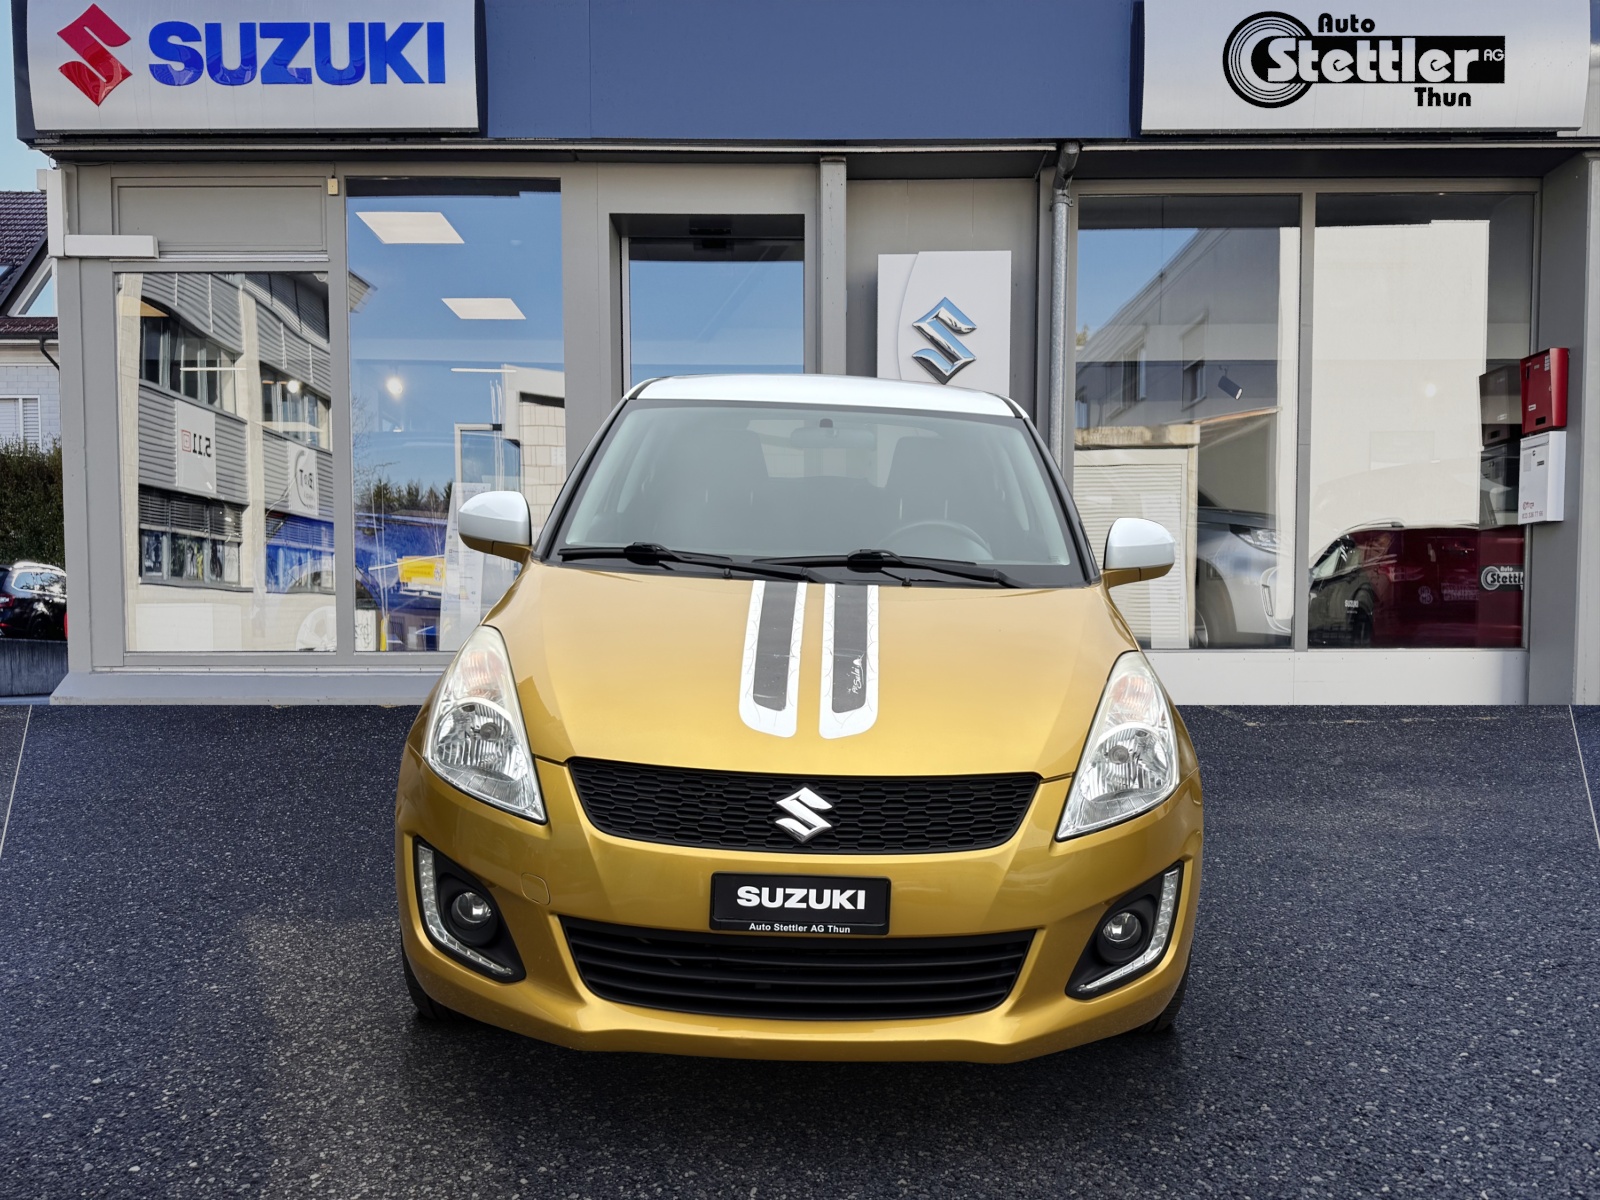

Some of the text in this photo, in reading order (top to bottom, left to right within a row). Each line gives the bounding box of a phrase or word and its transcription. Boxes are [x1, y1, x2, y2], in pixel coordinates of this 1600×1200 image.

[1317, 12, 1376, 33] Auto
[147, 20, 446, 86] SUZUKI
[1266, 37, 1505, 83] Stettler AG
[1413, 87, 1472, 108] Thun
[1490, 572, 1524, 584] Stettl
[736, 885, 866, 910] SUZUKI
[749, 922, 851, 934] Auto Stettler AG Thun
